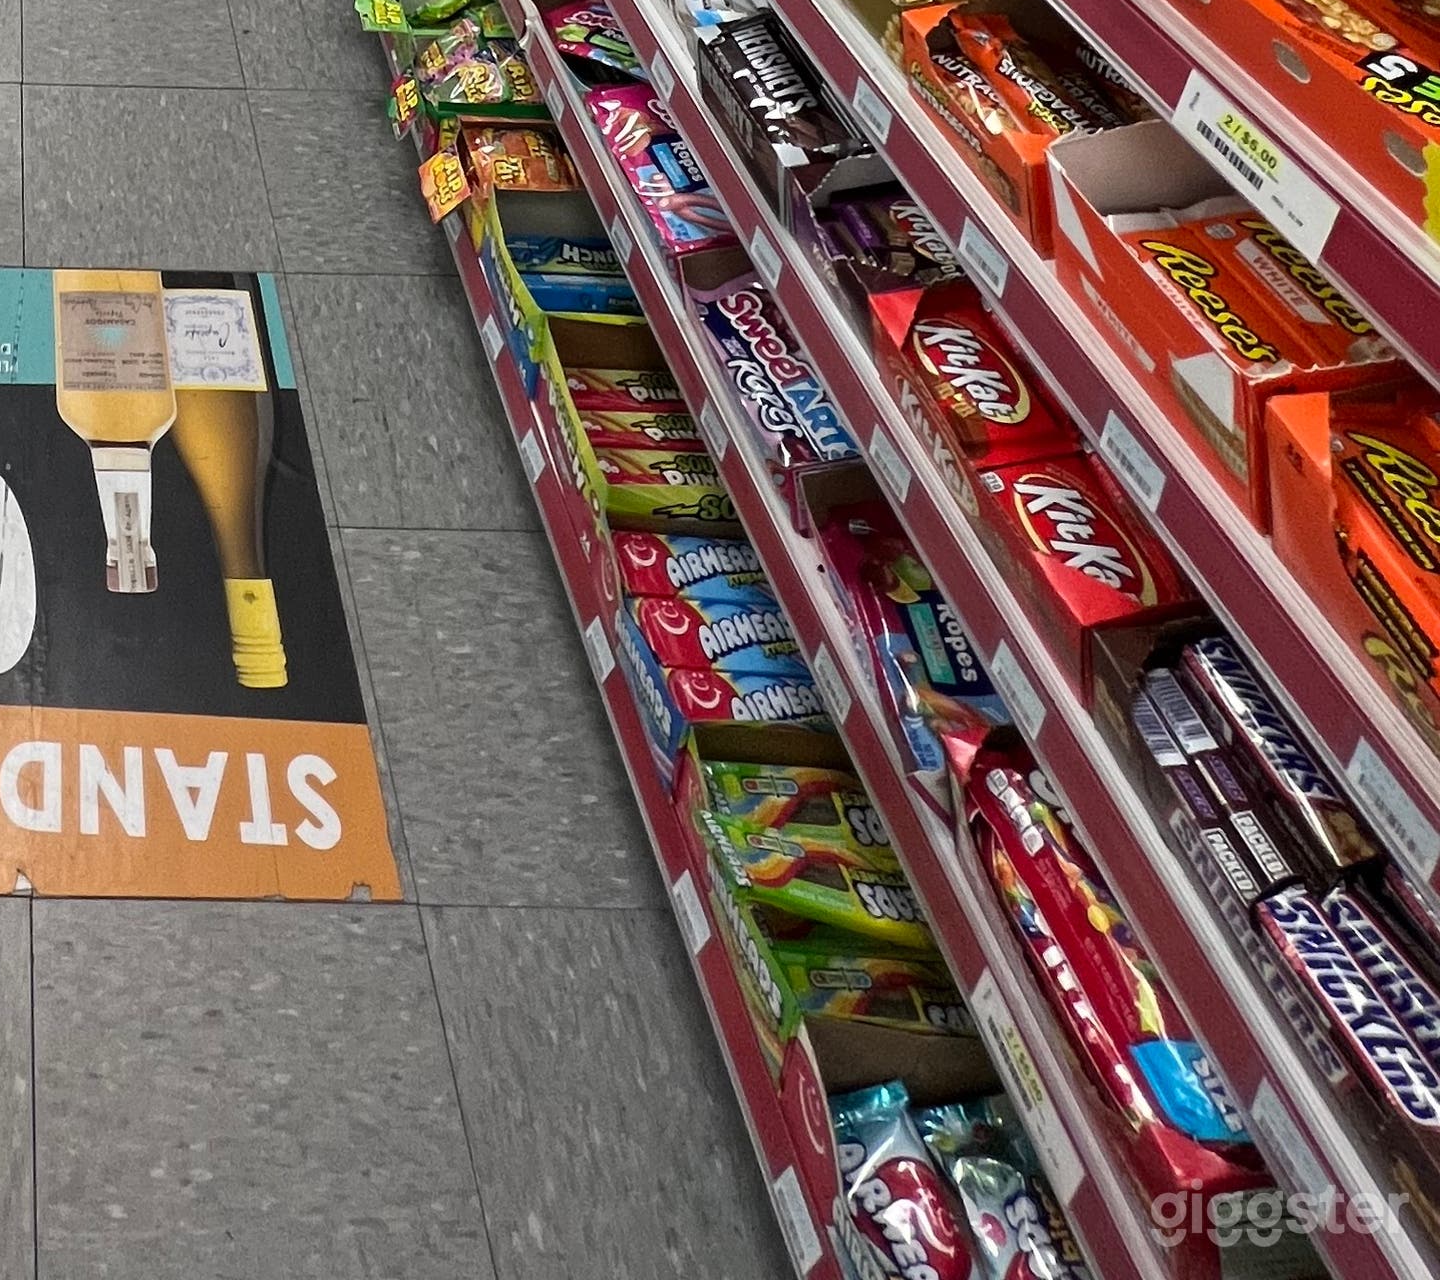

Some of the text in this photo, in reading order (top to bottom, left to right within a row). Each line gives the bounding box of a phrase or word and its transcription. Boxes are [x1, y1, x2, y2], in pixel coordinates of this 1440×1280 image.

[731, 21, 819, 115] HERSHEY'S
[1252, 253, 1307, 312] WHITE
[1208, 830, 1256, 896] PACKED
[1235, 811, 1286, 877] PACKED
